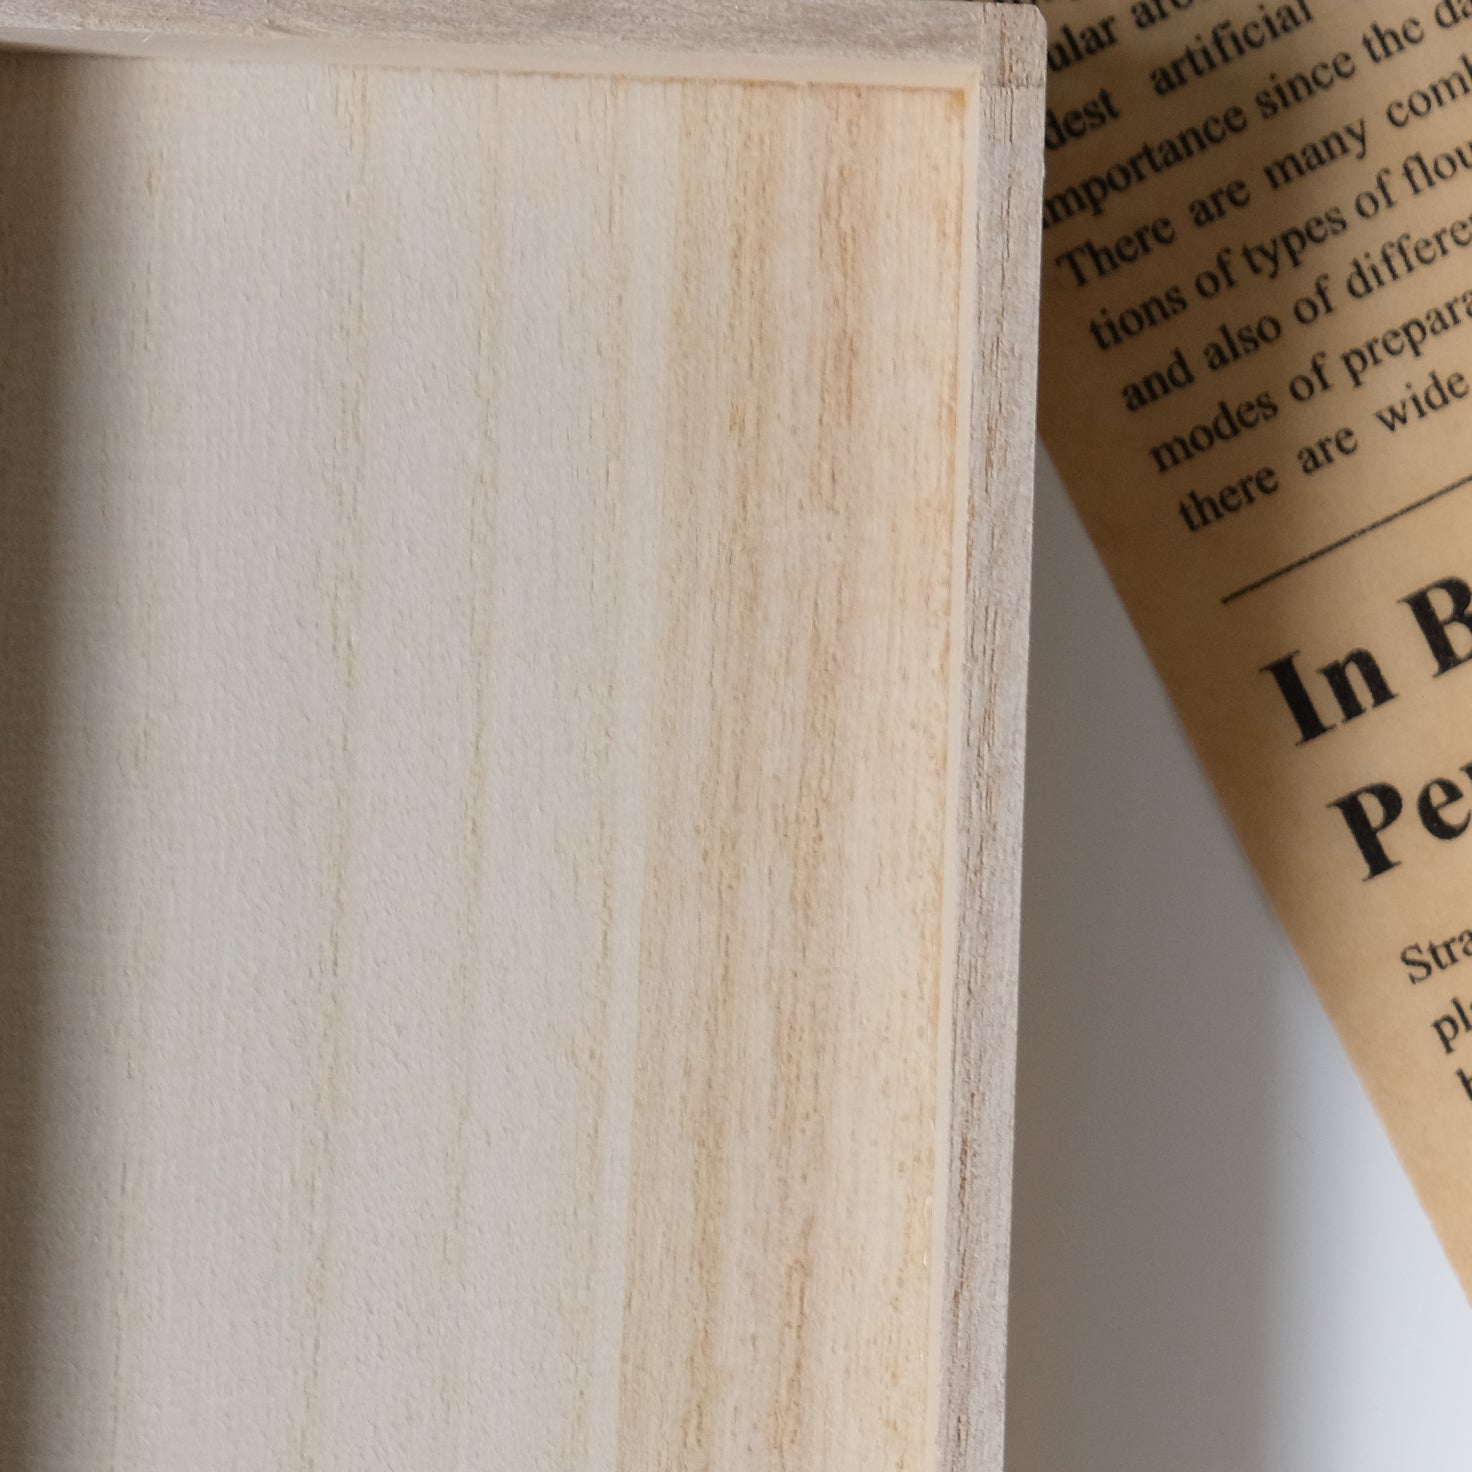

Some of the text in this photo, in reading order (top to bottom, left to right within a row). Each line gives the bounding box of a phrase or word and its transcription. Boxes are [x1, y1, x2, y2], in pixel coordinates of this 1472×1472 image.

[1043, 105, 1247, 230] mportance
[1255, 51, 1355, 119] since
[1361, 17, 1424, 64] the
[1150, 0, 1313, 97] artificial
[1055, 217, 1175, 287] There
[1188, 180, 1250, 227] are
[1264, 118, 1367, 190] many
[1089, 285, 1188, 351] tions
[1195, 247, 1237, 298] of
[1241, 206, 1347, 280] types
[1354, 167, 1397, 219] of
[1121, 346, 1195, 412] and
[1203, 315, 1281, 371] also
[1293, 273, 1334, 324] of
[1150, 391, 1278, 473] modes
[1289, 351, 1333, 402] of
[1178, 466, 1279, 532] there
[1297, 427, 1358, 474] are
[1375, 370, 1470, 432] wide
[1259, 647, 1398, 747] In
